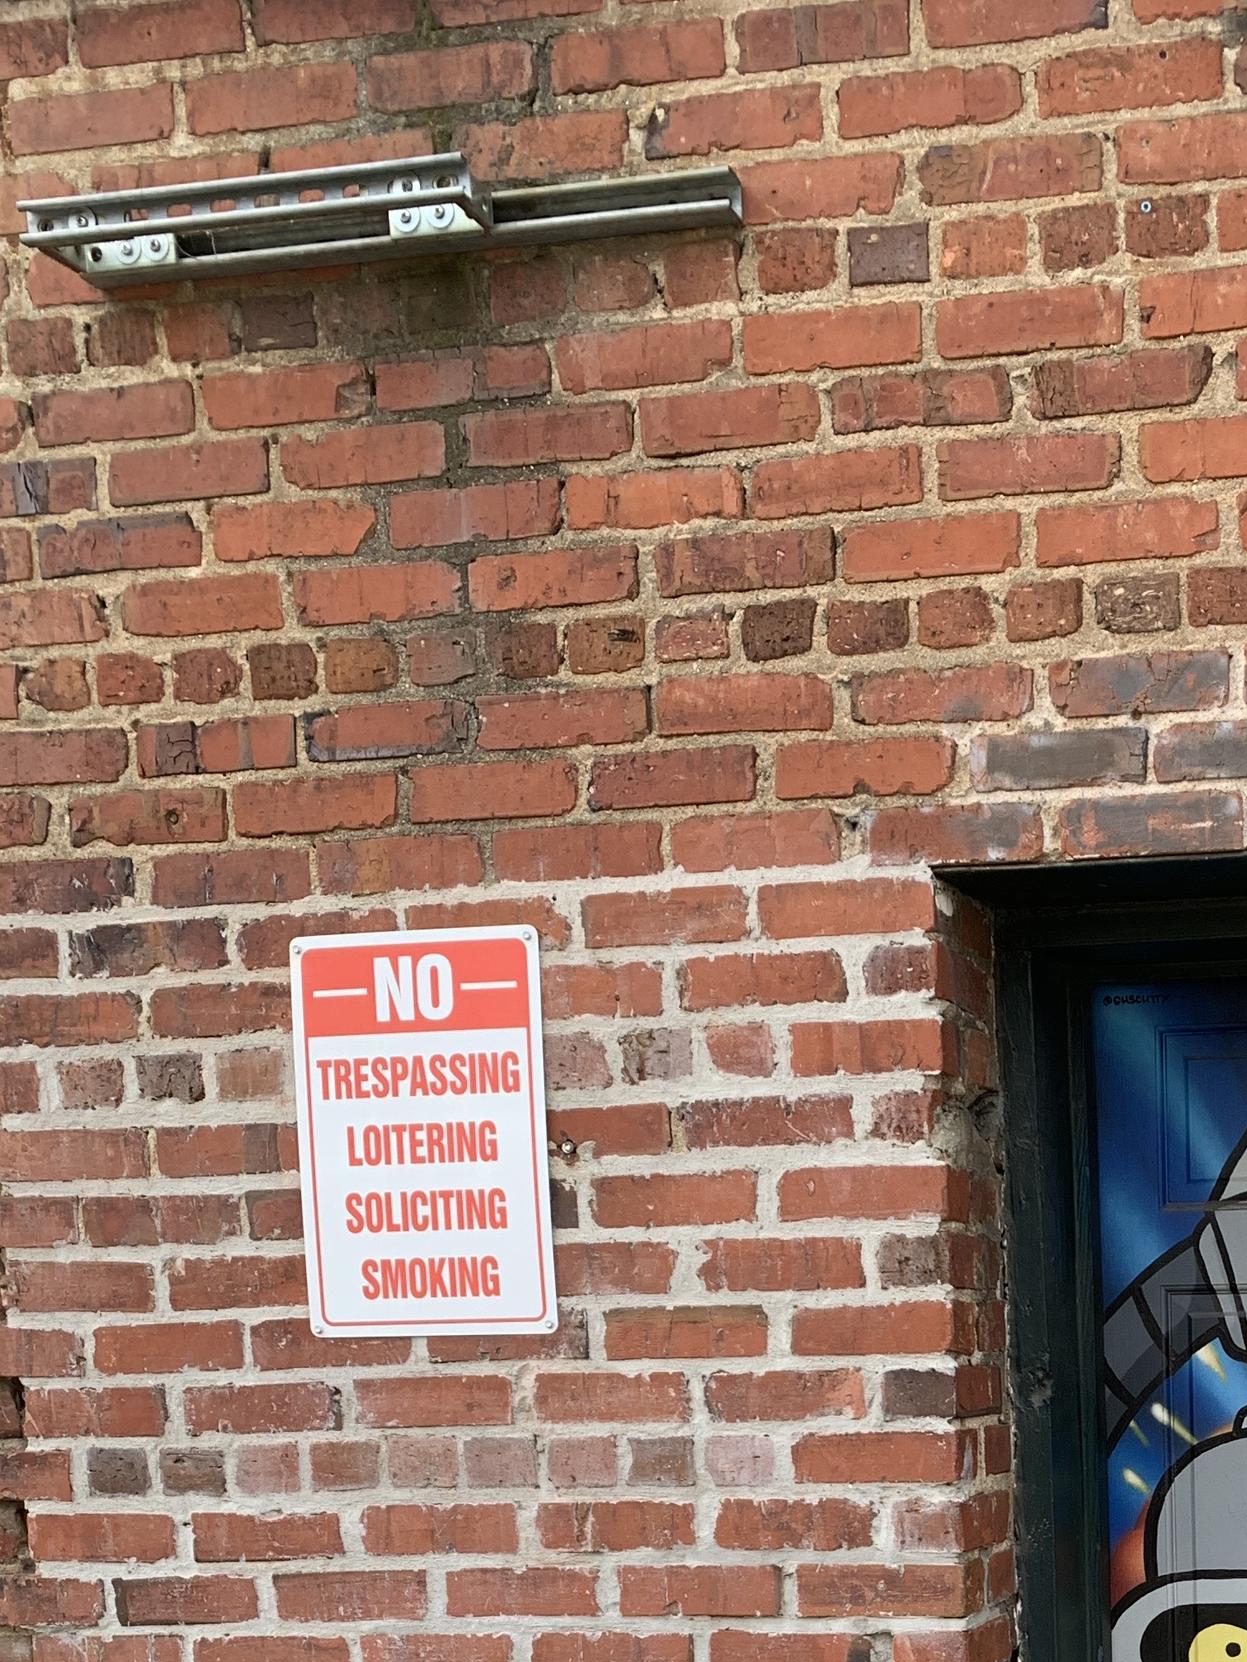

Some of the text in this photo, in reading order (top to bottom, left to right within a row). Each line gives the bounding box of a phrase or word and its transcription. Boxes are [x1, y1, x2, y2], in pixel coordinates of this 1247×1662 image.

[373, 953, 454, 1023] NO
[316, 1051, 521, 1101] TRESPASSING
[346, 1120, 499, 1167] LOITERING
[345, 1187, 508, 1234] SOLICITING
[361, 1255, 501, 1300] SMOKING
